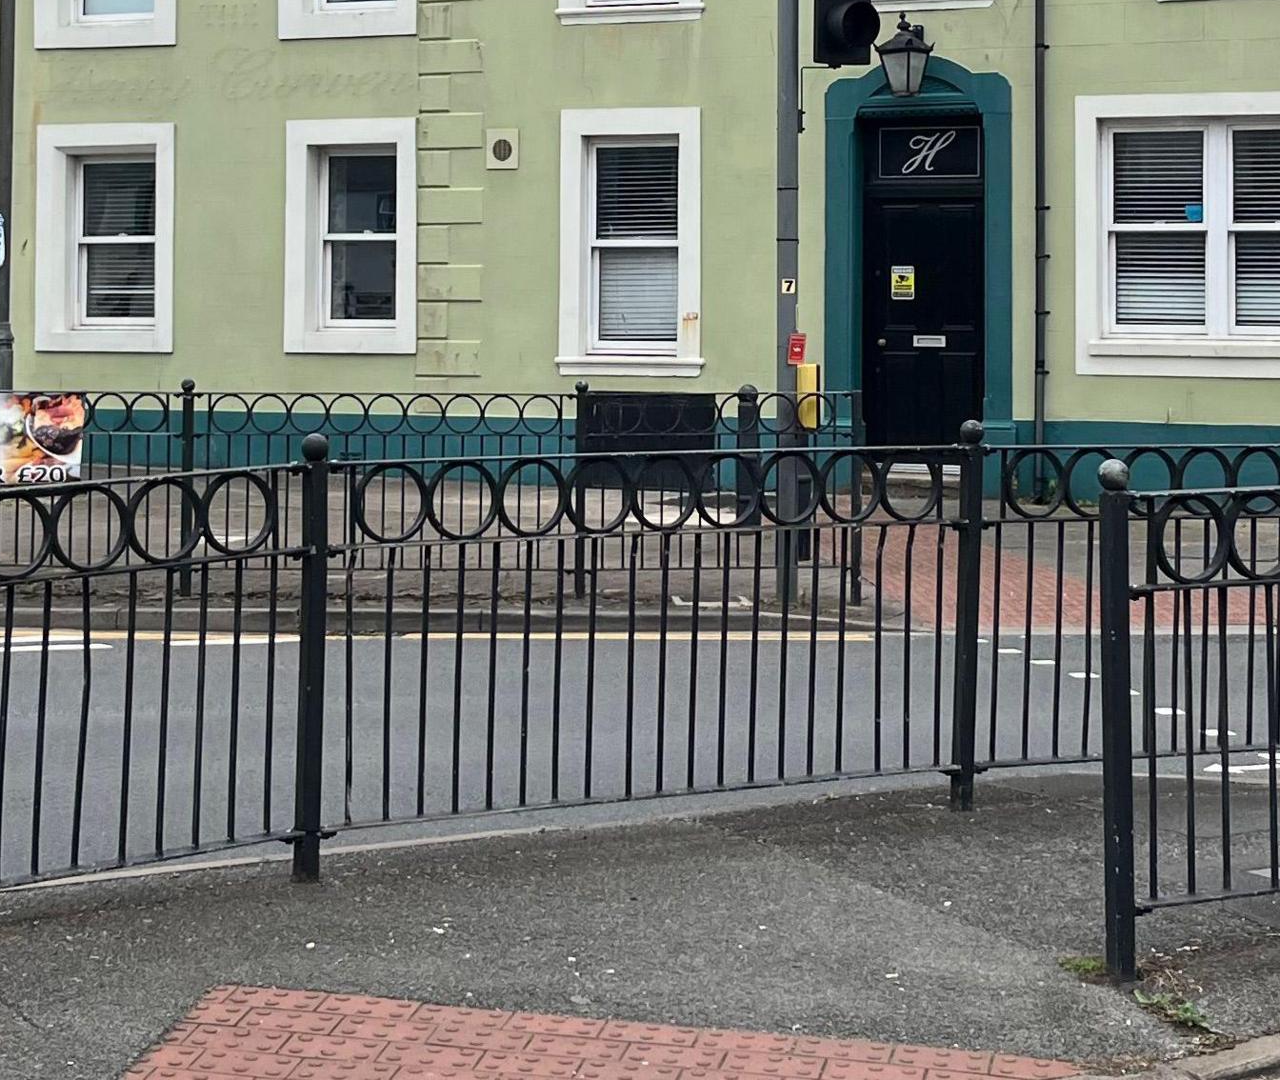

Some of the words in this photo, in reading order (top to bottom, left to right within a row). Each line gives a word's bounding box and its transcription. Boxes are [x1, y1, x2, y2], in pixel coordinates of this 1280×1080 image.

[902, 130, 956, 174] H
[784, 280, 794, 292] 7
[17, 466, 67, 483] £20
